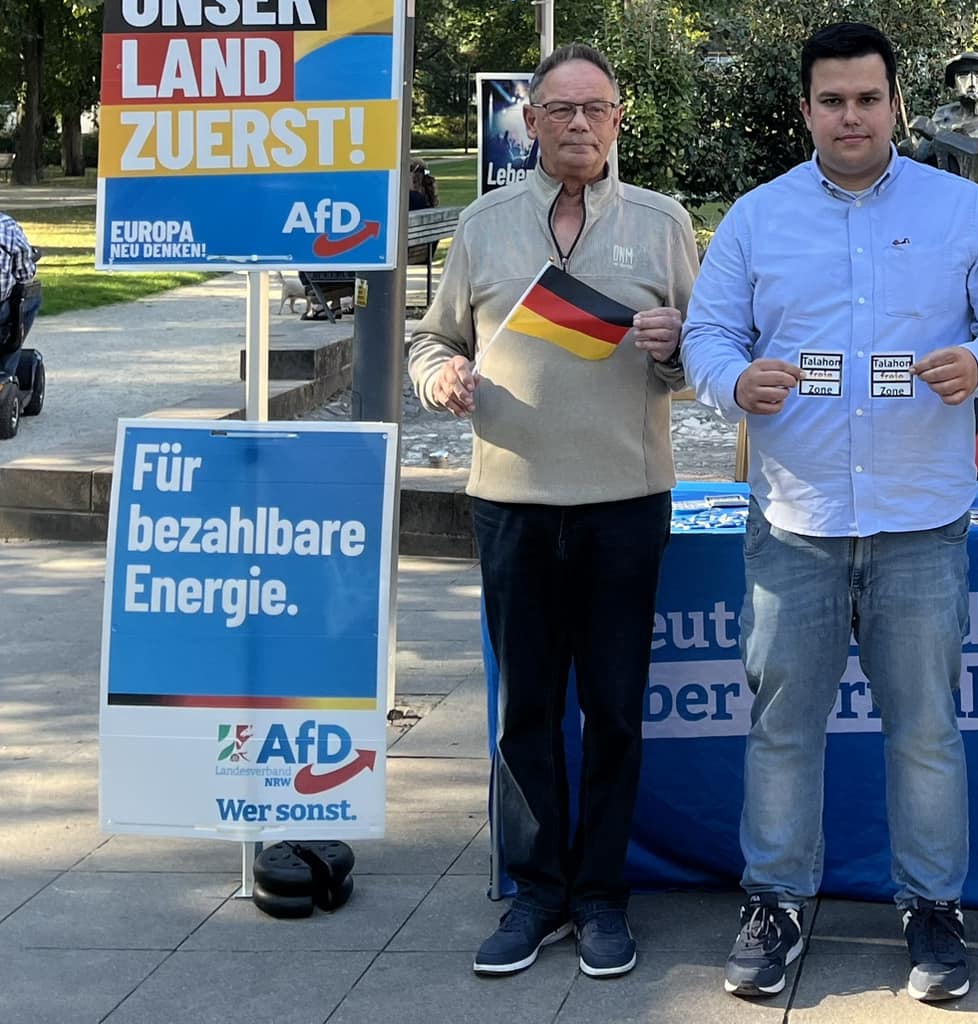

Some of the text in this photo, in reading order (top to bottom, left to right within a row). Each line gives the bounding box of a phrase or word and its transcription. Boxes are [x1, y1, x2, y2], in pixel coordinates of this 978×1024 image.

[121, 38, 281, 99] LAND
[119, 107, 366, 172] ZUERST!
[111, 221, 194, 243] EUROPA
[282, 198, 361, 234] AfD
[111, 243, 207, 258] NEU DENKEN!
[808, 385, 832, 395] Zone
[880, 387, 904, 396] Zone
[132, 442, 203, 492] Für
[128, 504, 365, 556] bezahlbare
[124, 564, 299, 628] Energie.
[649, 679, 740, 722] ber
[256, 719, 352, 764] AfD
[215, 765, 291, 776] Landesverband
[264, 778, 291, 787] NRW
[215, 799, 357, 821] Wer sonst.
